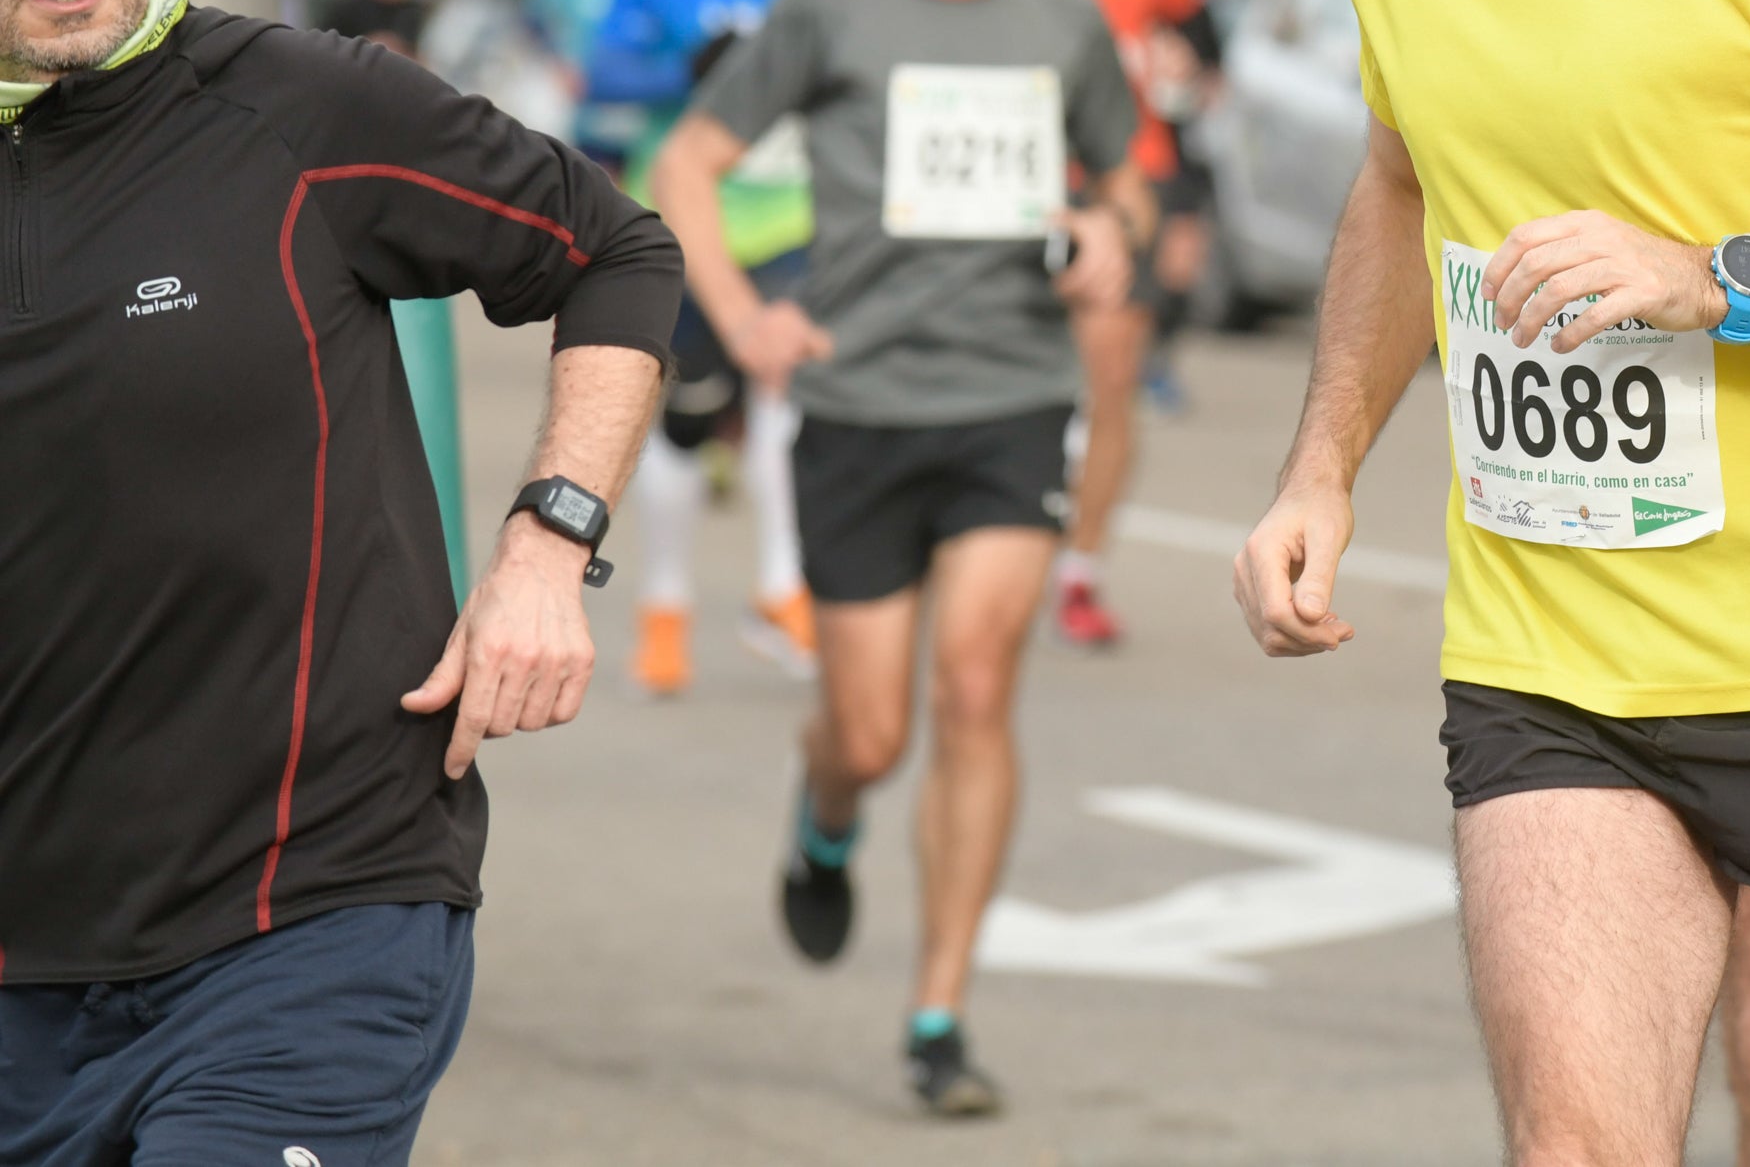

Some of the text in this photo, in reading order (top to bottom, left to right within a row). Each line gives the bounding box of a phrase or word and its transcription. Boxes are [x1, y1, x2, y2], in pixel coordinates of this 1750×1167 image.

[126, 292, 198, 319] Kalenji
[1594, 336, 1604, 345] de
[1606, 335, 1629, 346] 2020,
[1472, 352, 1667, 465] 0689
[1519, 469, 1533, 482] en
[1537, 468, 1548, 483] el
[1551, 469, 1590, 489] barrio,
[1594, 476, 1629, 489] como
[1633, 475, 1650, 488] en
